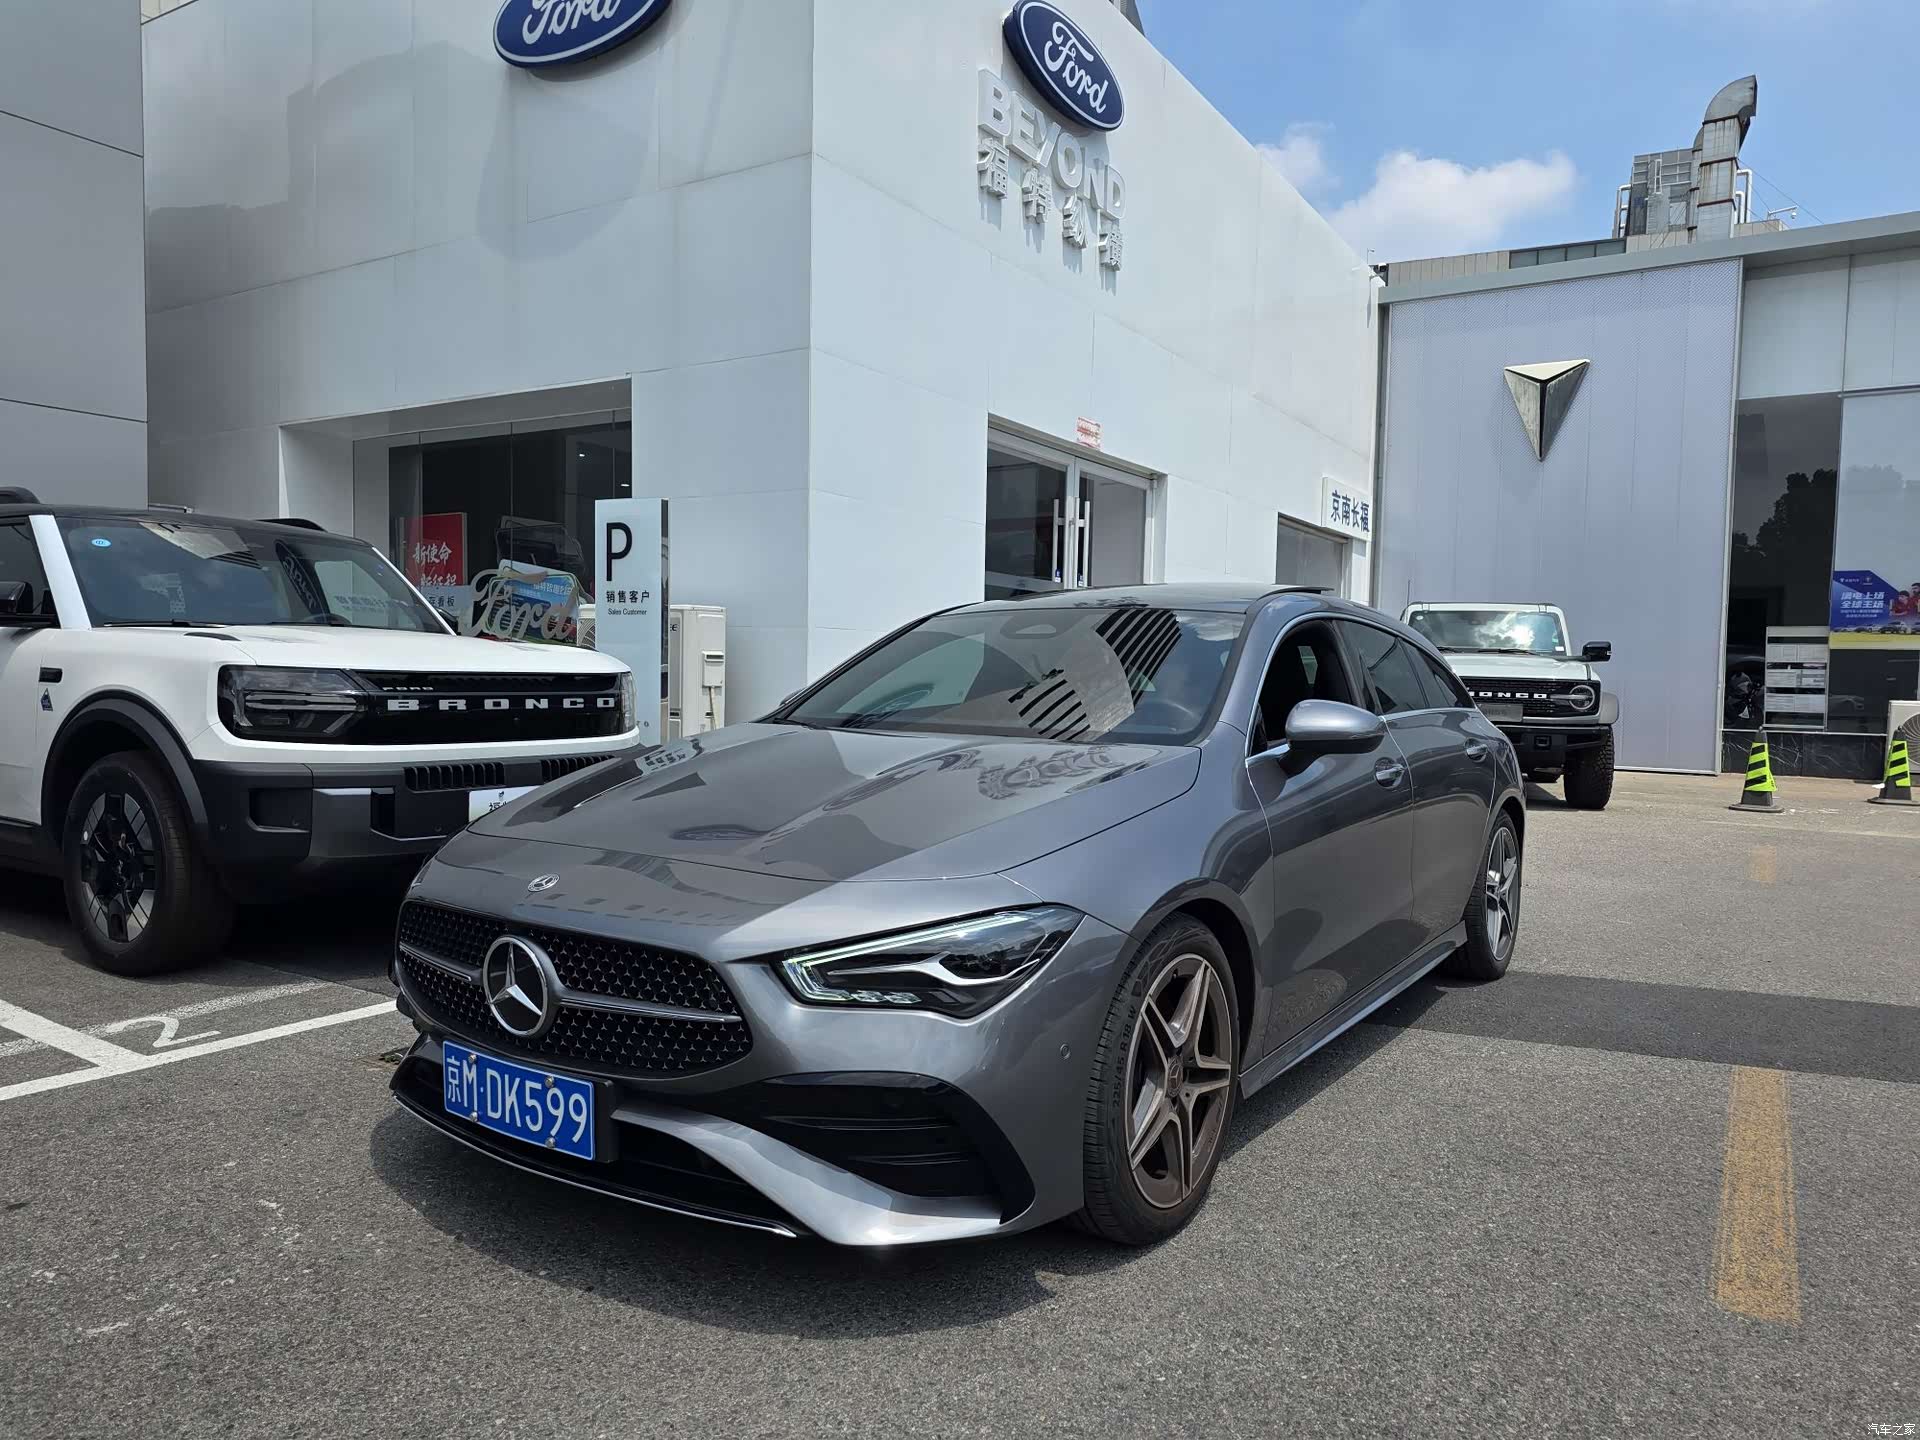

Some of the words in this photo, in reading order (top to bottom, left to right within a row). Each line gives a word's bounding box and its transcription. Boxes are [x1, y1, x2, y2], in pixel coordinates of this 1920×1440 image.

[1044, 21, 1109, 114] Ford
[977, 67, 1126, 220] BEYOND
[977, 138, 1122, 271] 福特纵横
[1331, 490, 1370, 532] 京南长福
[412, 541, 452, 566] 新使命
[606, 522, 633, 582] P
[458, 568, 578, 641] Ford
[606, 590, 650, 603] 销售客户
[387, 697, 615, 711] BRONCO
[106, 1016, 221, 1048] 2
